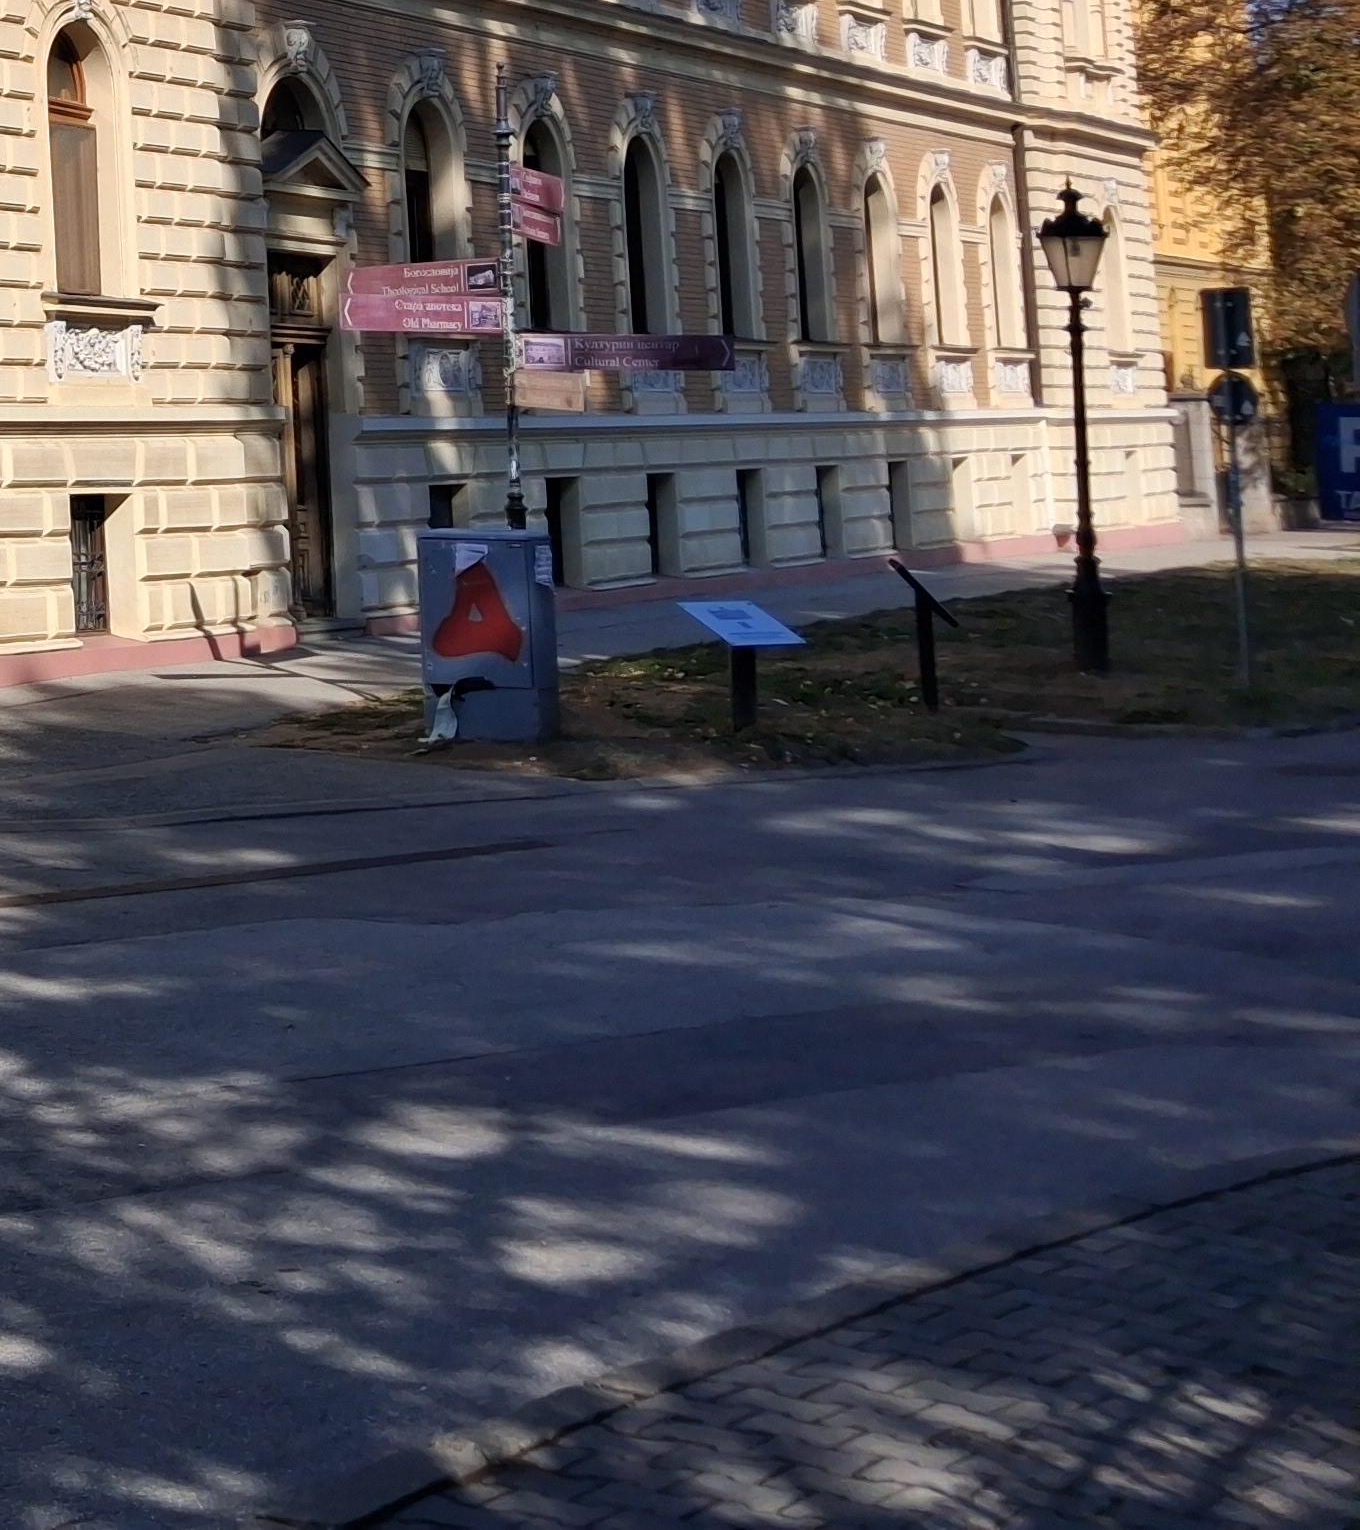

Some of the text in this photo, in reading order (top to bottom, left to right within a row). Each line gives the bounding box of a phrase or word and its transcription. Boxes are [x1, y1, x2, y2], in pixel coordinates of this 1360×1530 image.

[431, 282, 459, 294] School
[402, 317, 419, 328] Old
[574, 356, 661, 367] Cultural Center
